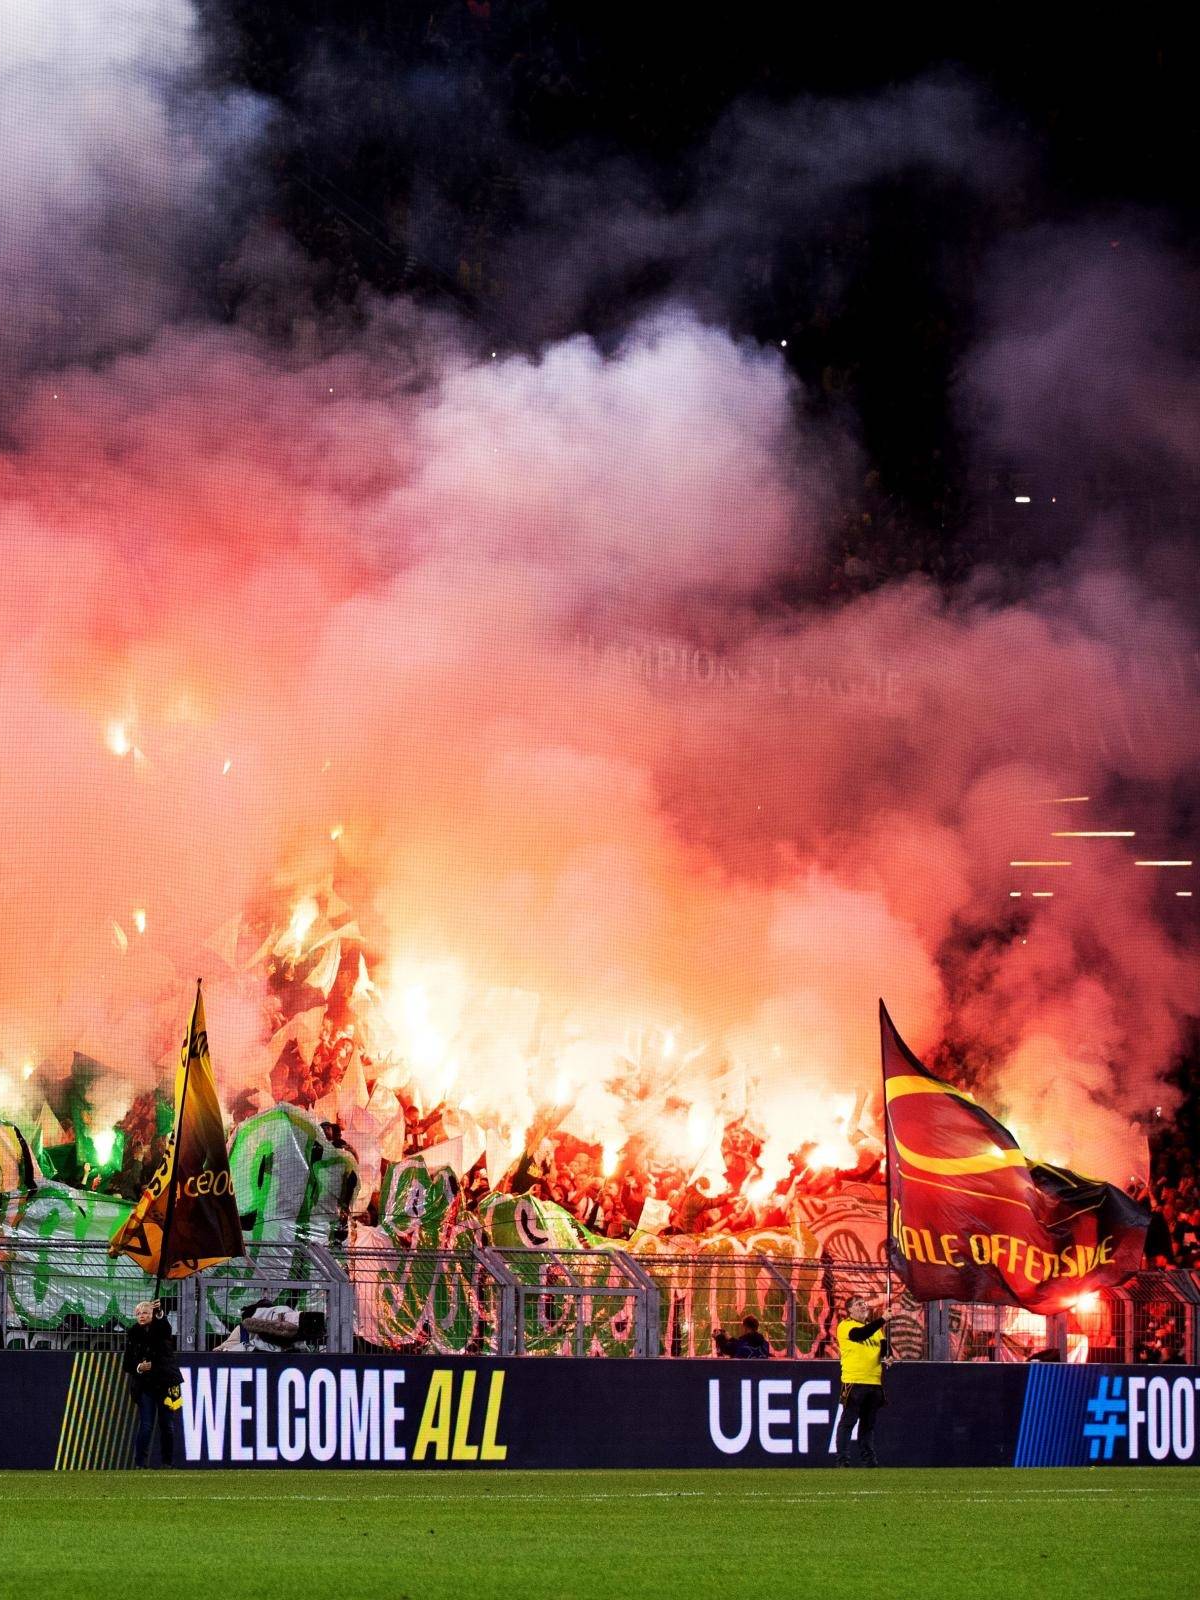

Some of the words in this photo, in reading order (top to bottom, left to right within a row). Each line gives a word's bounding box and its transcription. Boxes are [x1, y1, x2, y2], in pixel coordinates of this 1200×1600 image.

[180, 1367, 407, 1462] WELCOME
[412, 1369, 508, 1461] ALL
[708, 1378, 860, 1454] UEF
[1083, 1375, 1200, 1460] #FOO
